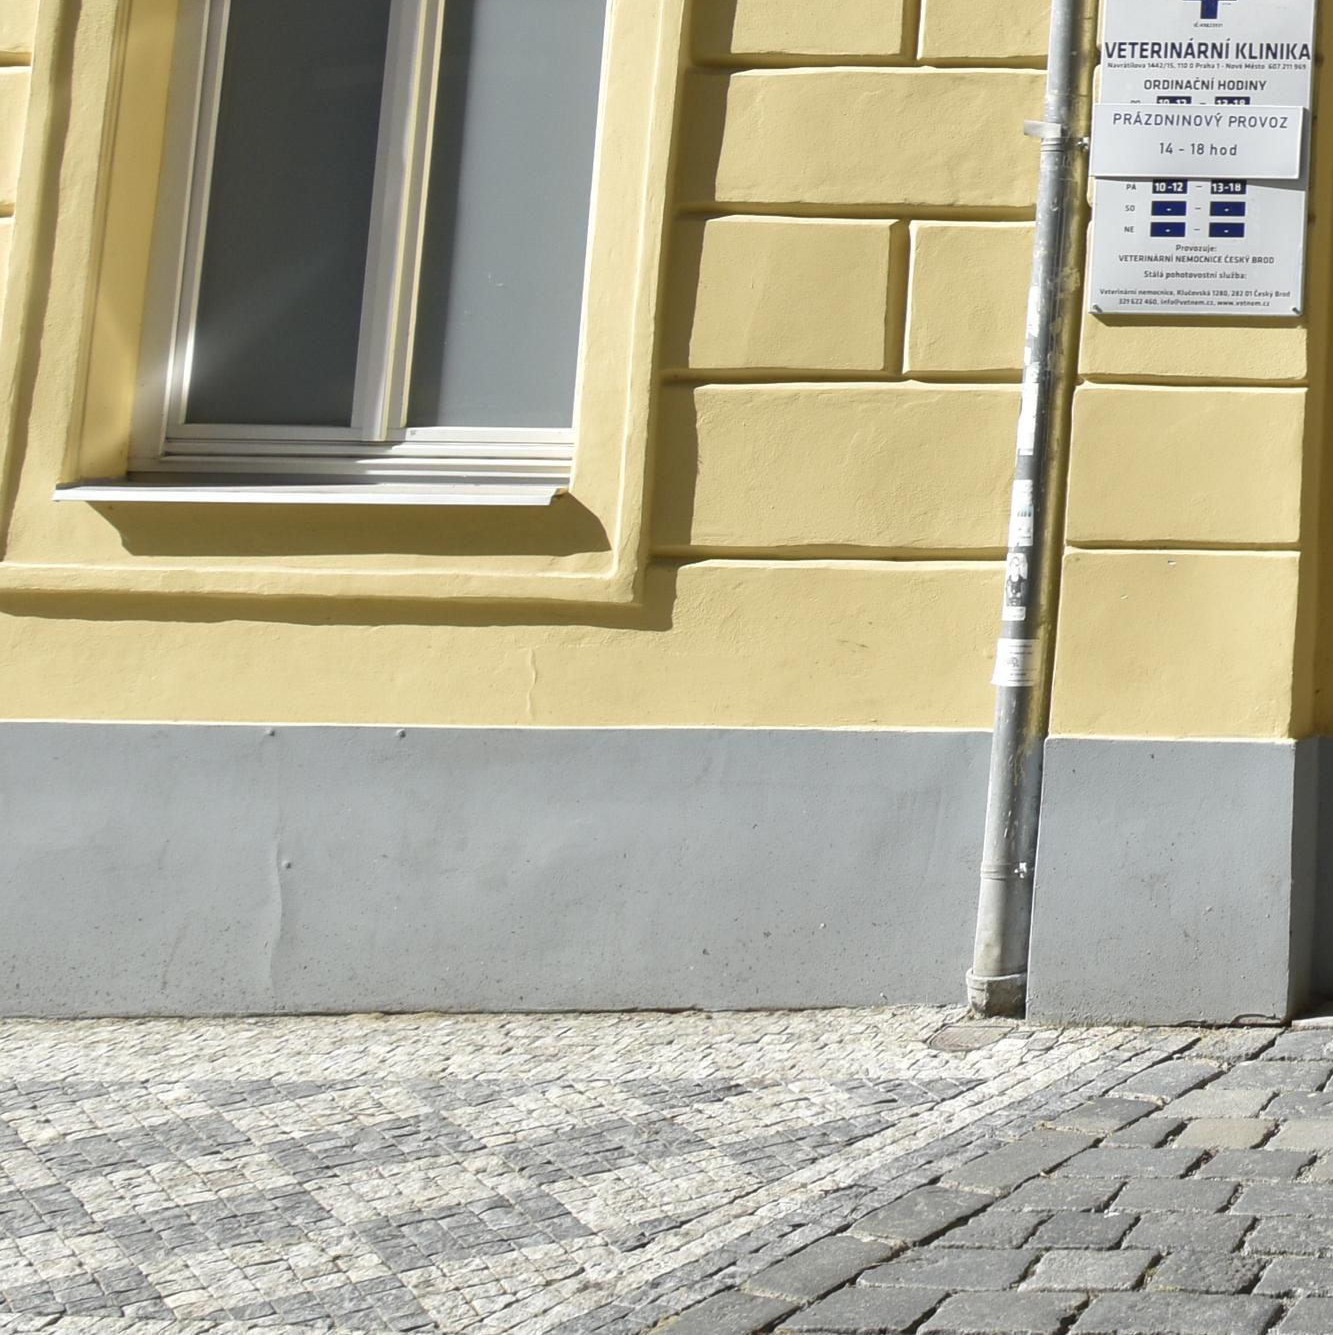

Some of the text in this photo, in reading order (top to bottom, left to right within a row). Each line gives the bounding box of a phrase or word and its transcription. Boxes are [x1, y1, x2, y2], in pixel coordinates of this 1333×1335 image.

[1105, 38, 1311, 60] VETERINÁRNÍ KLINIKA
[1144, 77, 1267, 91] ORDINAČNÍ HODINY
[1113, 111, 1288, 128] PRÁZDNINOVÝ PROVOZ
[1160, 142, 1173, 154] 14
[1190, 143, 1204, 155] 18
[1210, 144, 1237, 156] hod
[1155, 182, 1183, 192] 10-12
[1212, 183, 1242, 192] 13-18
[1176, 244, 1217, 253] Provozuje:
[1119, 254, 1173, 262] VETERINÁRNÍ
[1175, 255, 1222, 263] NEMOCNICE
[1252, 256, 1275, 264] BROD
[1166, 271, 1217, 280] pohotovostní
